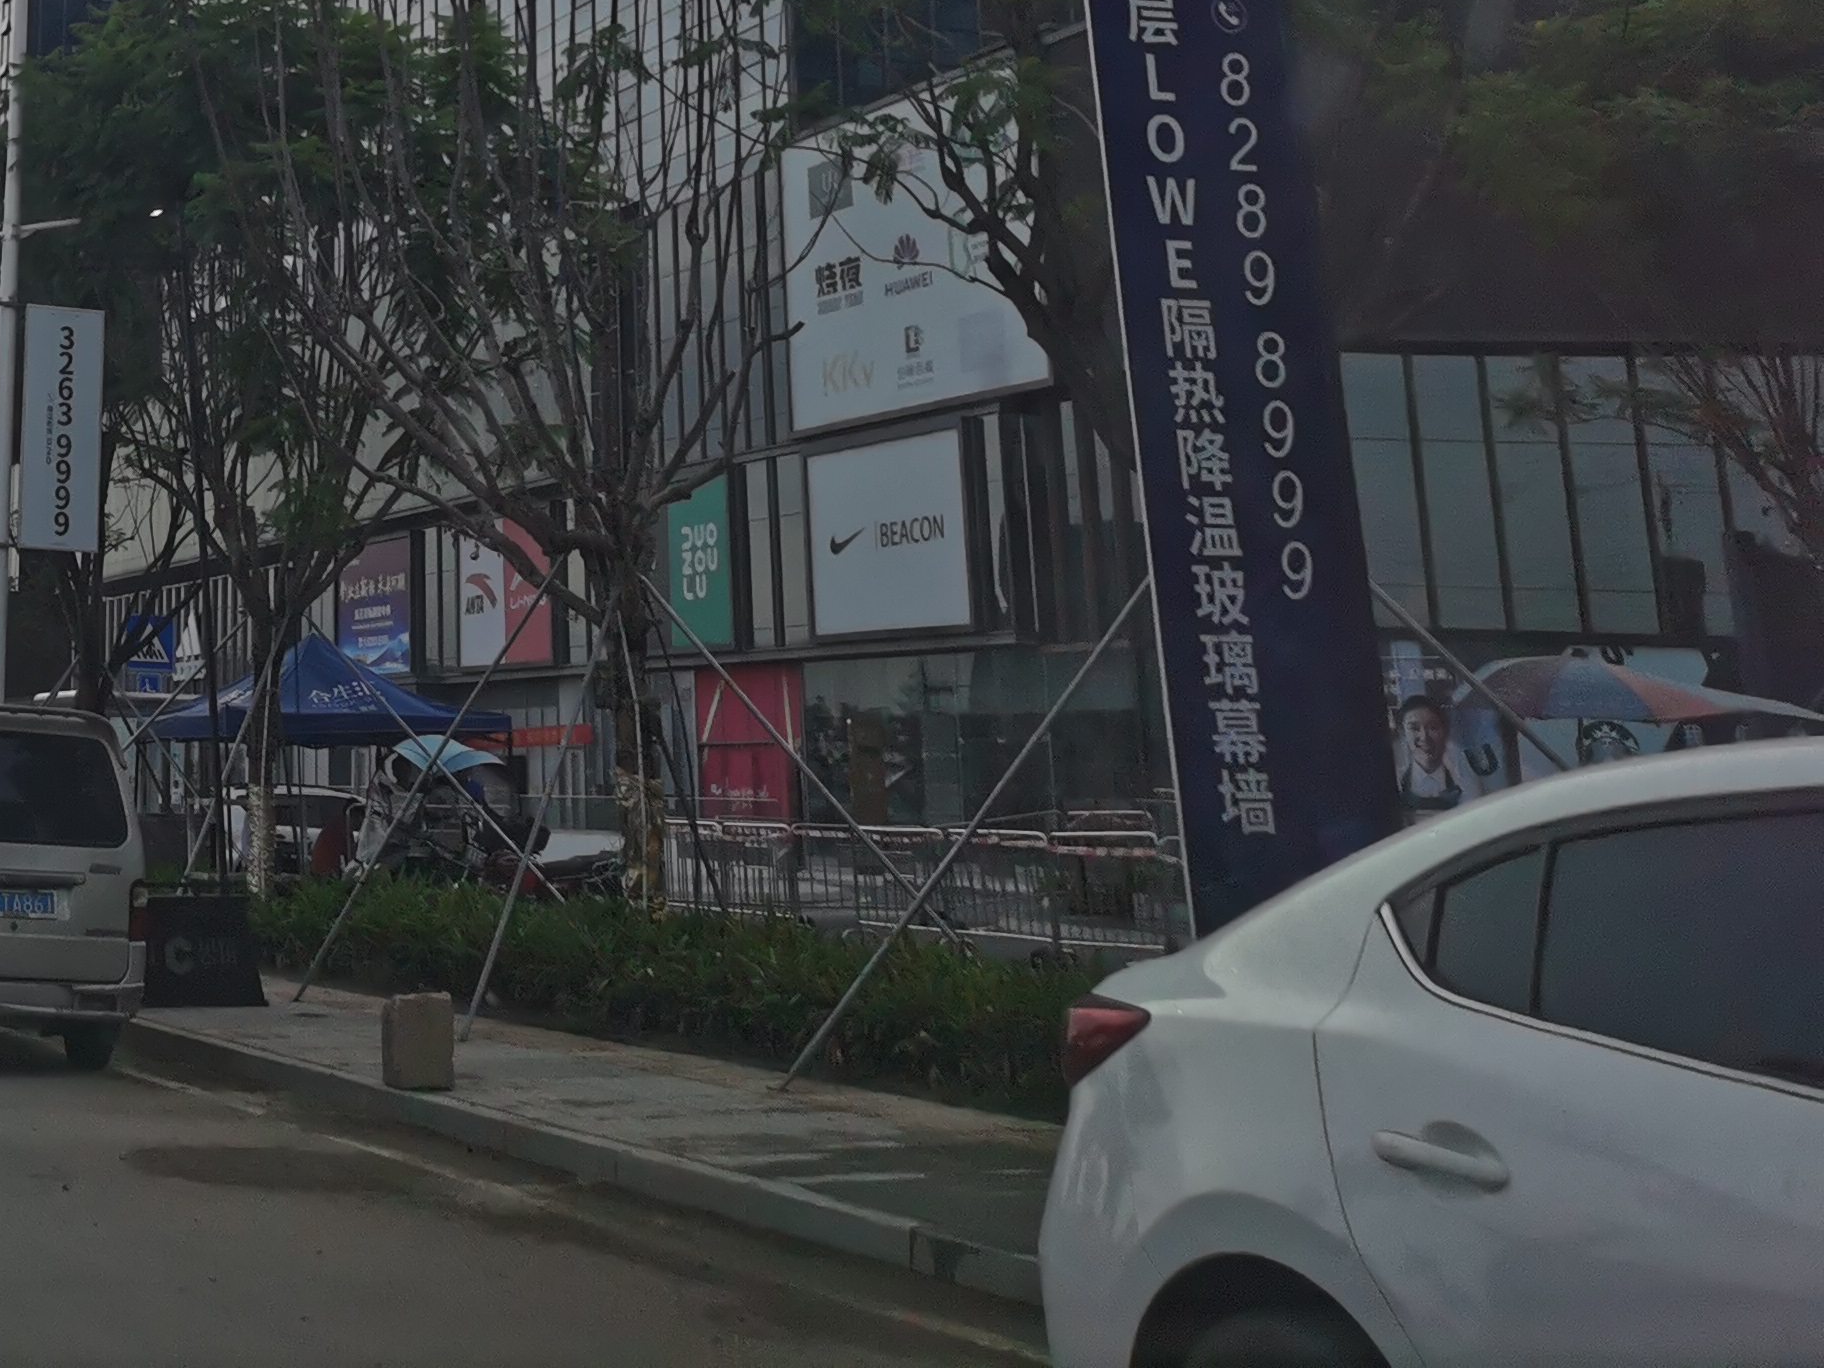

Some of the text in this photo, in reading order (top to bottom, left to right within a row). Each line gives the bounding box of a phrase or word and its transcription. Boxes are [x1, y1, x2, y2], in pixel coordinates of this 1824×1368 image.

[884, 271, 934, 297] HUAWEI
[681, 522, 718, 551] DUO
[880, 513, 945, 548] BEACON
[682, 547, 719, 575] ZOU
[683, 572, 707, 601] LU
